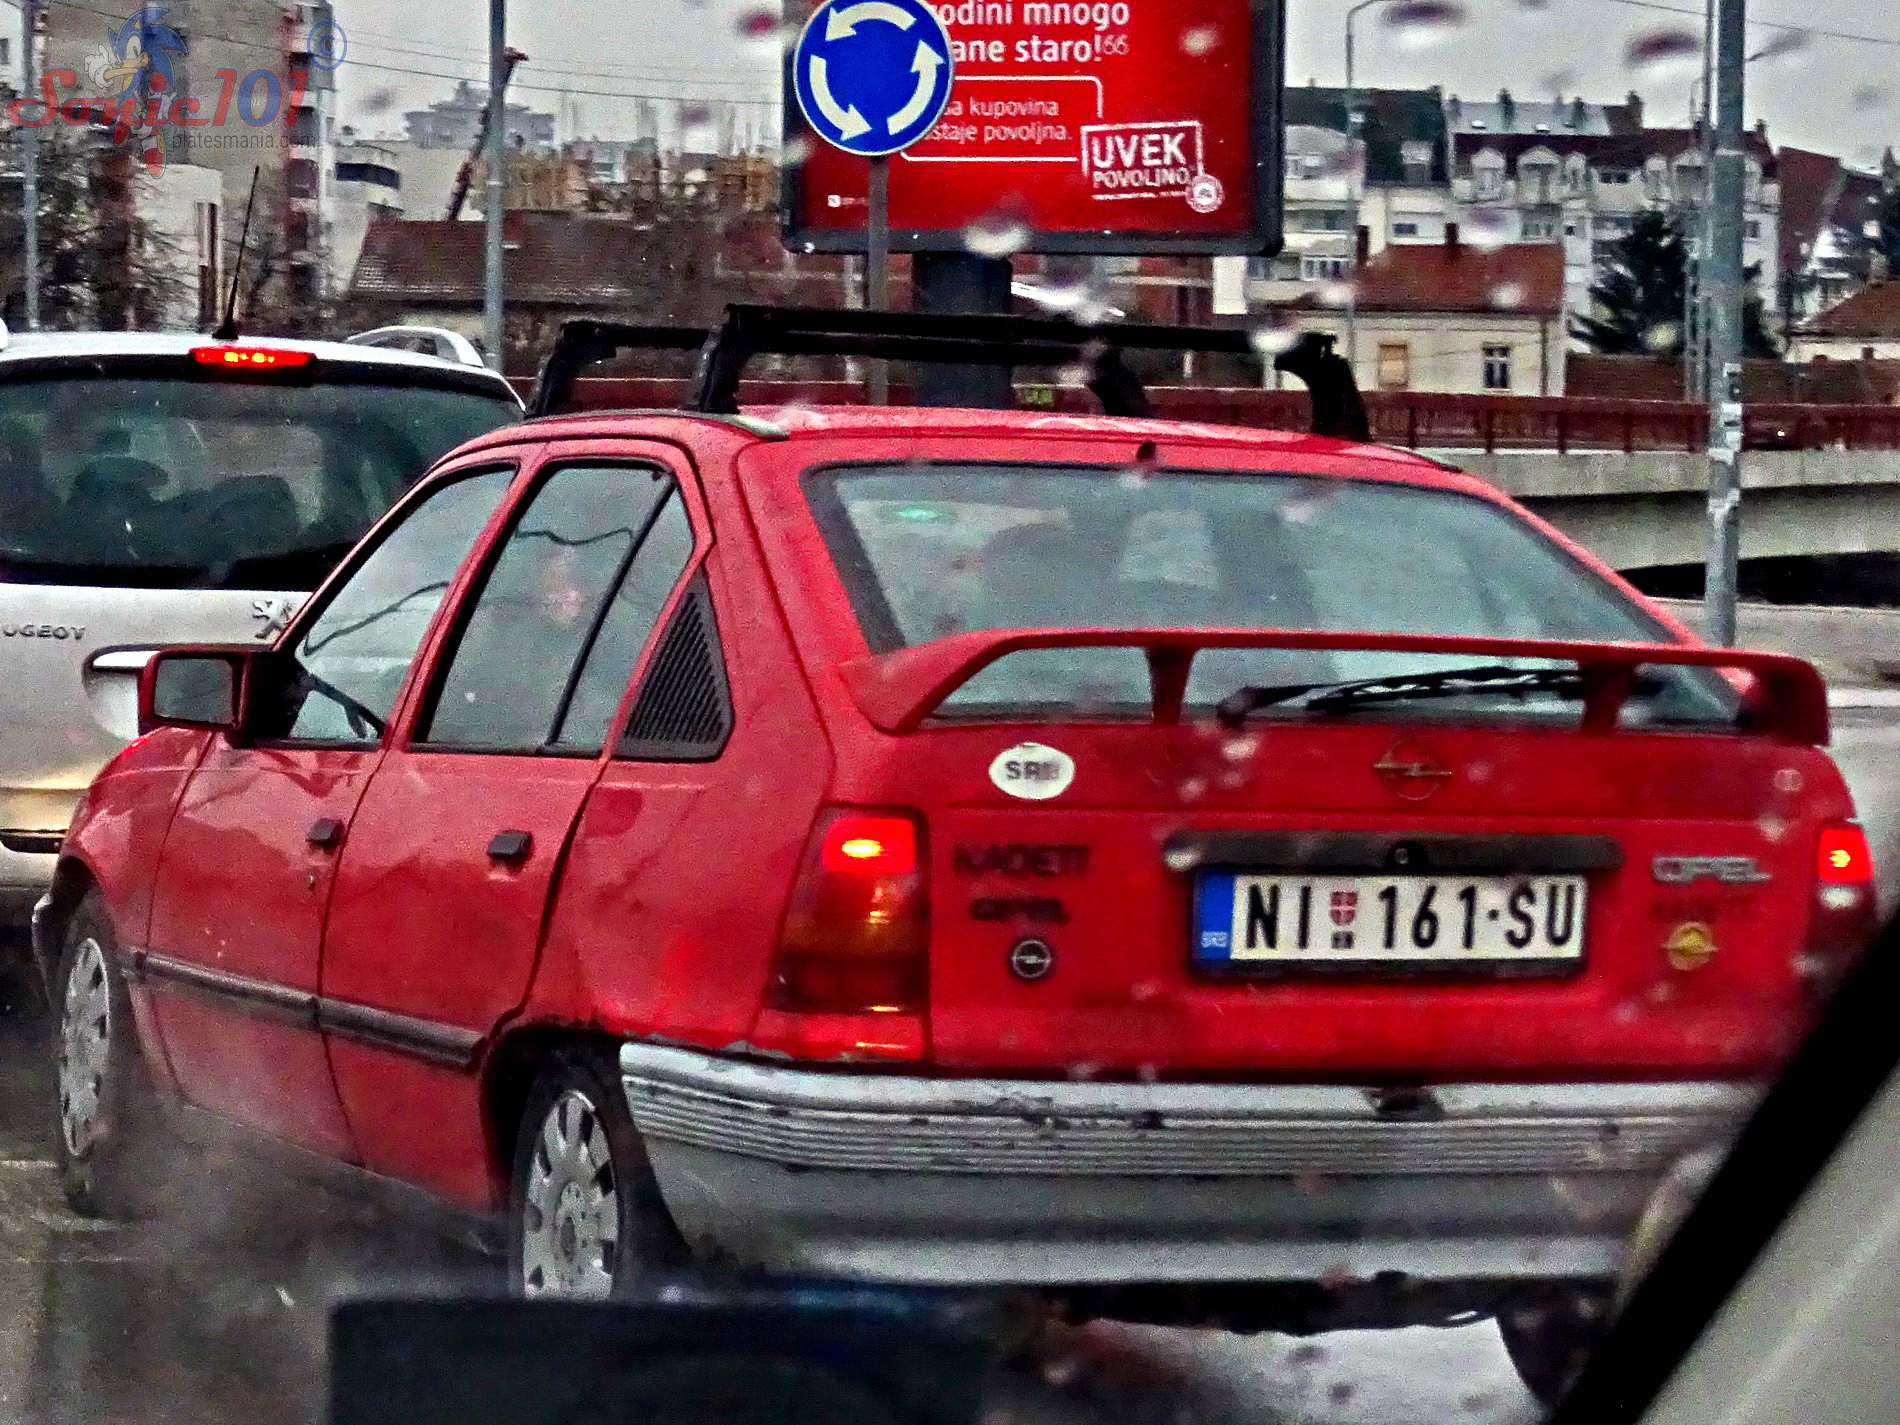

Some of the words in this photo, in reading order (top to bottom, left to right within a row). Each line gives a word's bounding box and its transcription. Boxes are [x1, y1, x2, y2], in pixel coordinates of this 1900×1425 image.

[928, 0, 1013, 25] odini
[1023, 2, 1129, 31] mnogo
[969, 96, 1059, 119] kupovina
[924, 121, 978, 144] staje
[983, 121, 1072, 144] povoljna.
[1091, 132, 1186, 168] UVEK
[1245, 884, 1312, 950] NI
